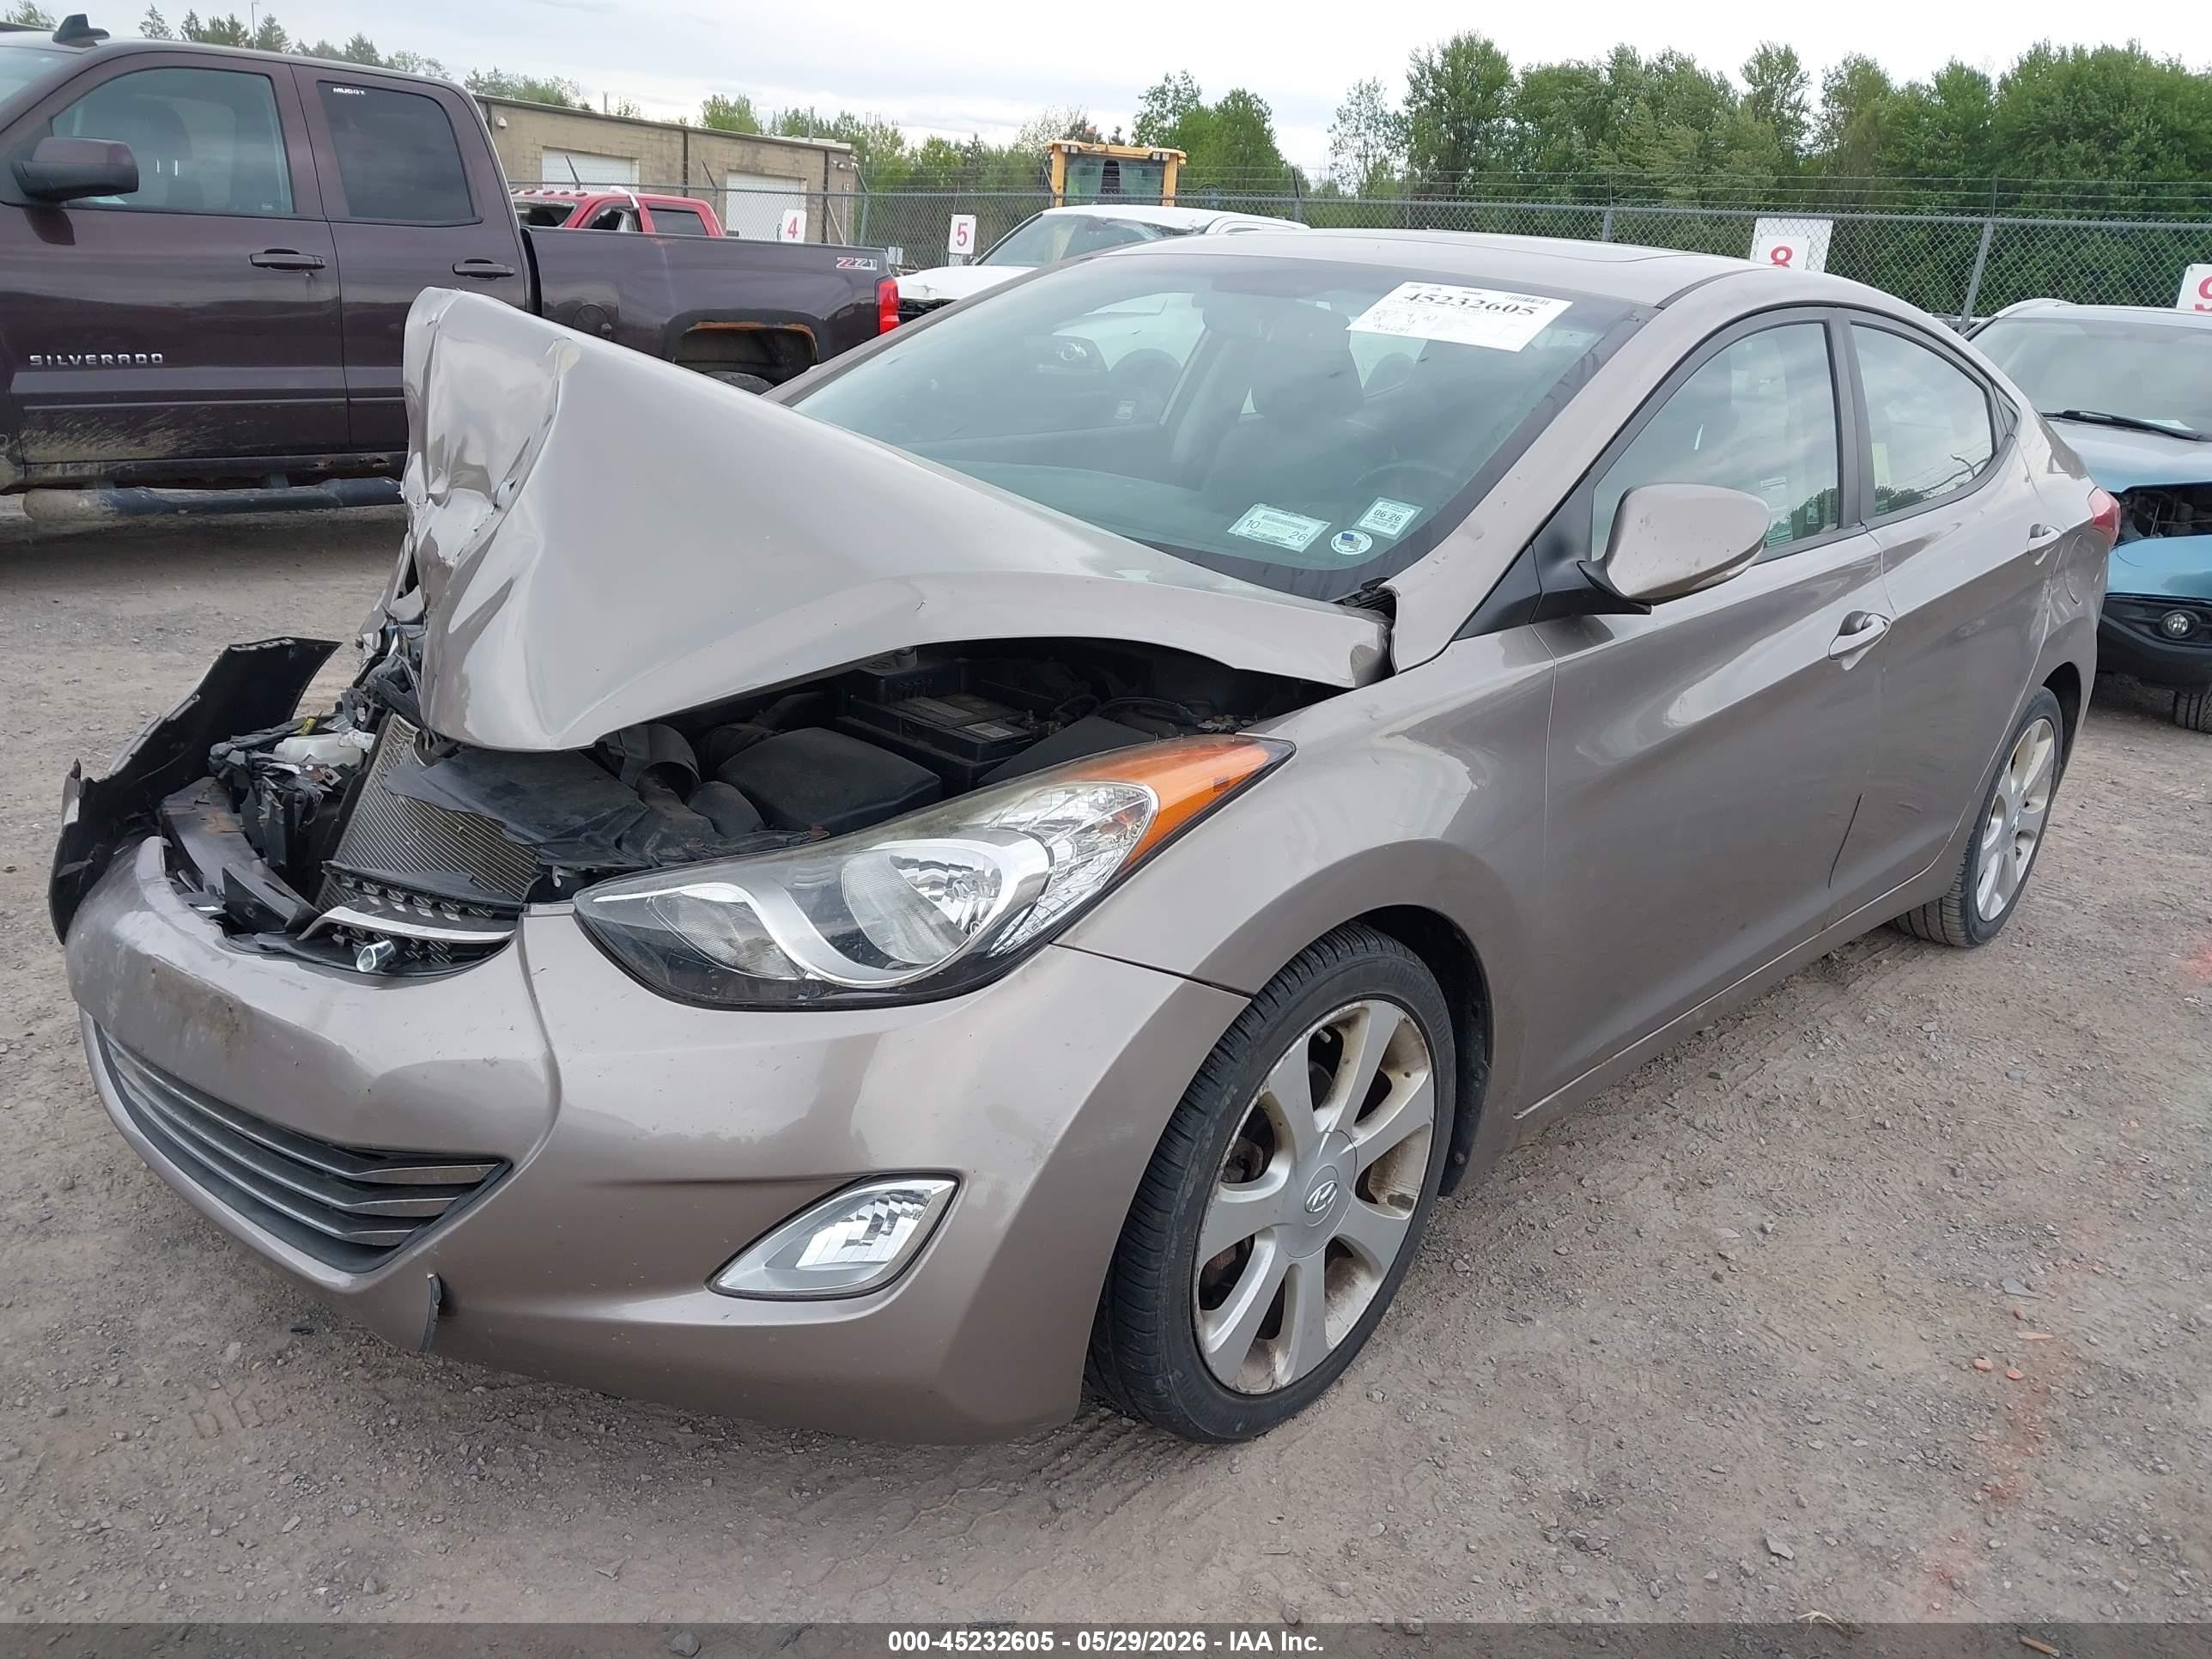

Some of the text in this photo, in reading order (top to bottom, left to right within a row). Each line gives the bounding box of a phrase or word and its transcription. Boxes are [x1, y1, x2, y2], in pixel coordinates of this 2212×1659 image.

[787, 216, 798, 239] 4
[956, 222, 969, 247] 5
[836, 257, 878, 270] Z71
[1403, 293, 1540, 315] 45232605
[29, 353, 163, 366] SILVERADO
[1374, 508, 1403, 522] 06 26
[1245, 520, 1261, 529] 10
[1289, 531, 1308, 542] 26
